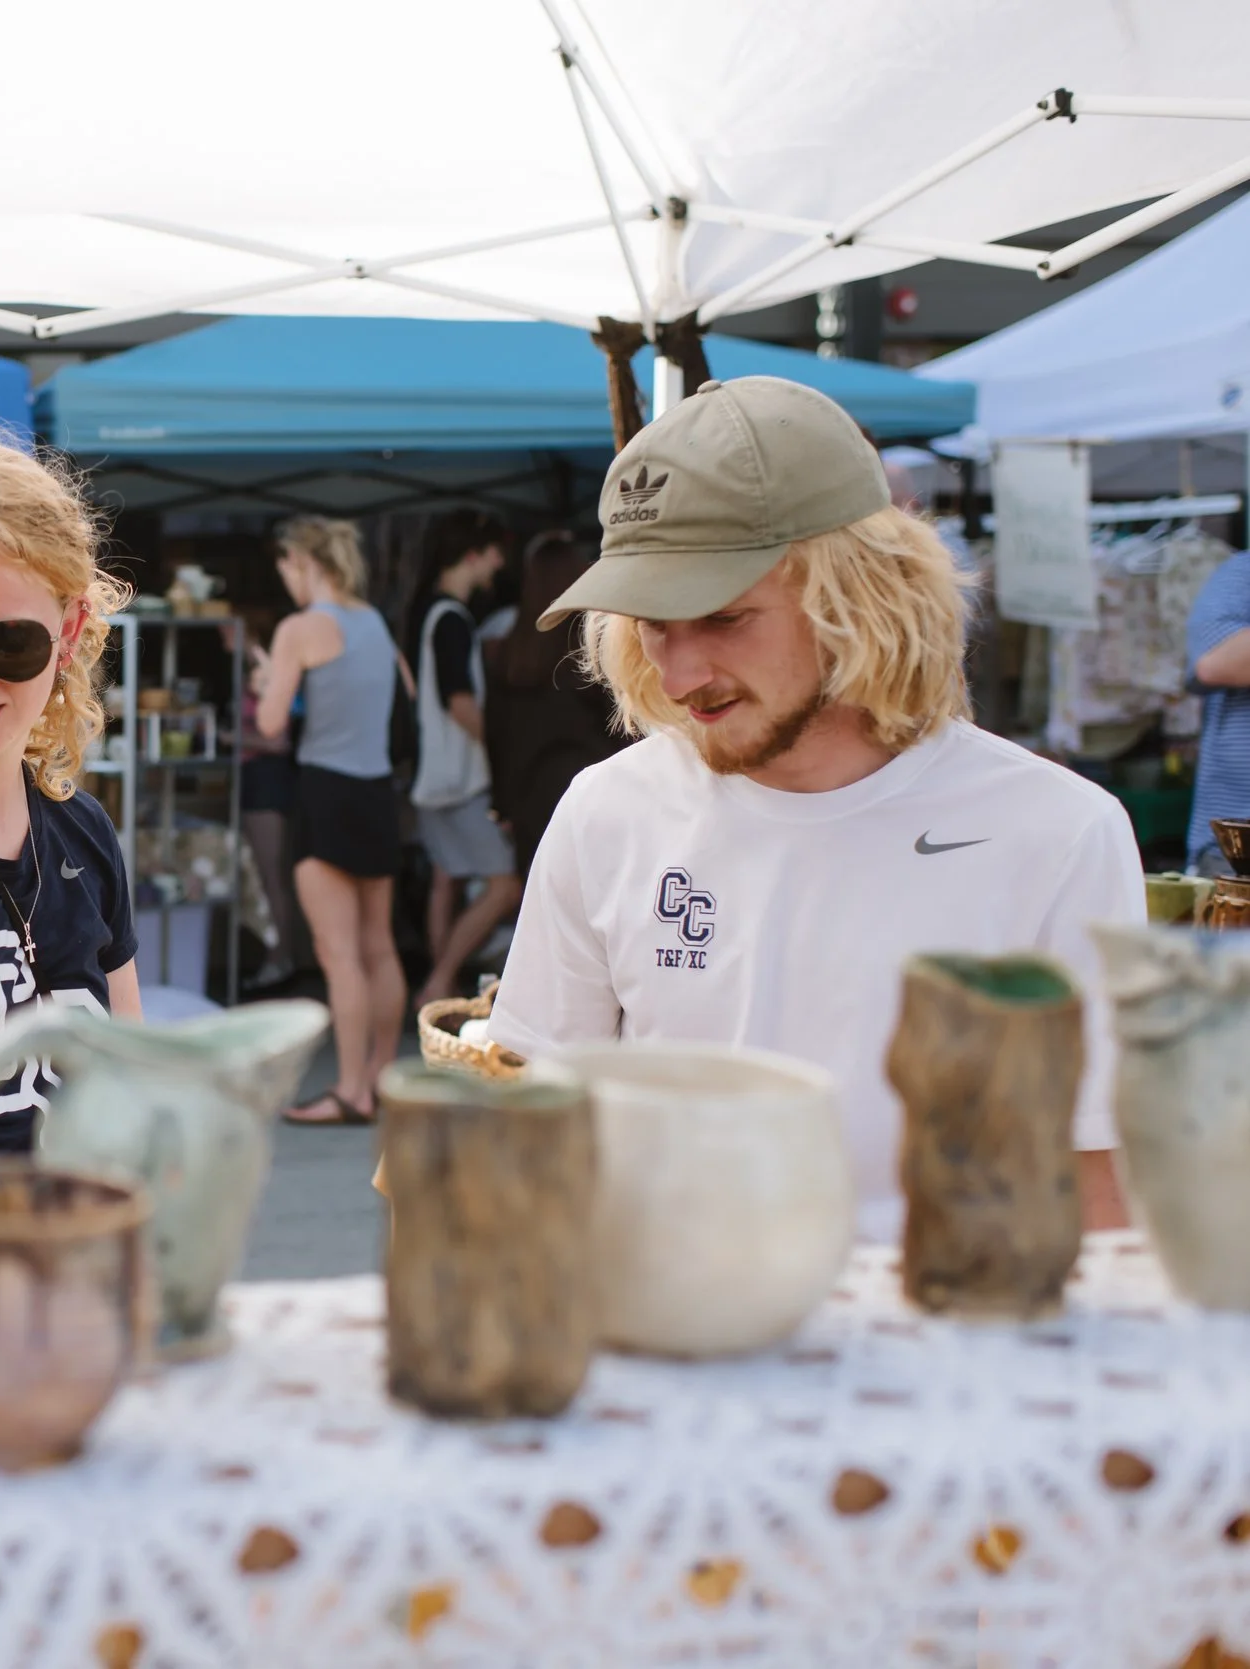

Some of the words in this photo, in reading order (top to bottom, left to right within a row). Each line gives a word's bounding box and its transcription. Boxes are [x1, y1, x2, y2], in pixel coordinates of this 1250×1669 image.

[609, 507, 659, 526] adidas
[653, 867, 716, 947] CC
[655, 948, 707, 969] T&F/XC
